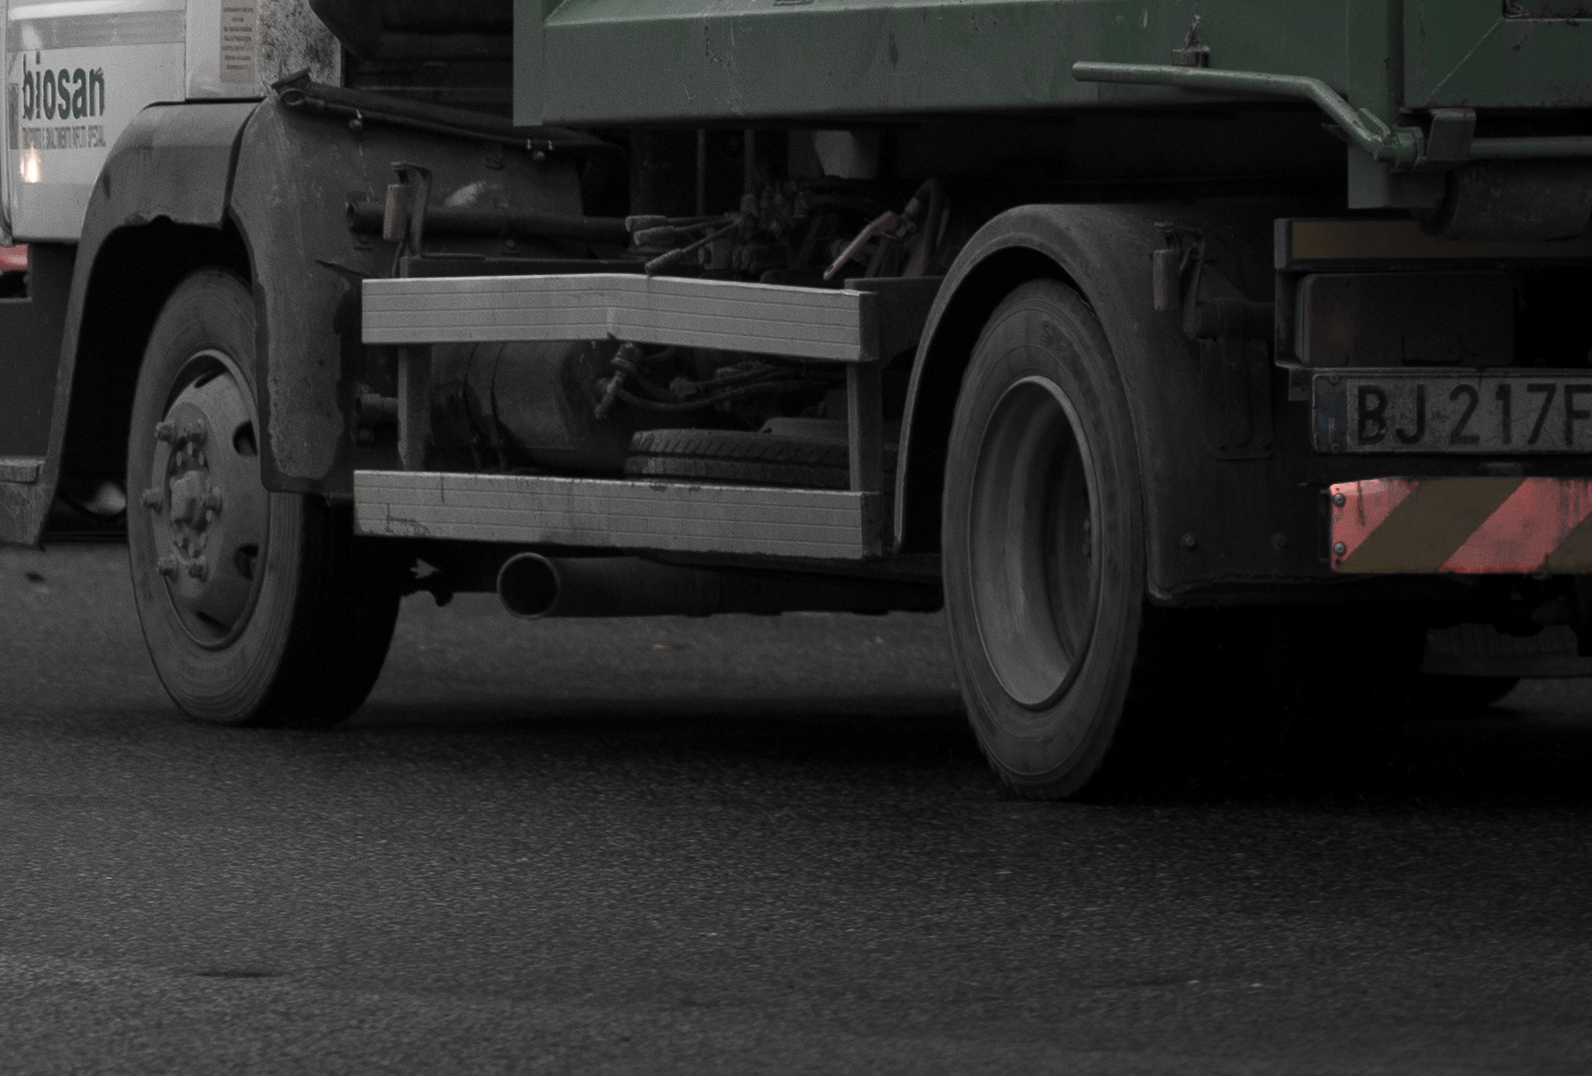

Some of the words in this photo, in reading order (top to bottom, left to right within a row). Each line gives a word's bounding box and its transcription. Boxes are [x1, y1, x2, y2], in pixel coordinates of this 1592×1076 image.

[22, 51, 105, 120] biosan
[1357, 383, 1426, 446] BJ
[1448, 382, 1592, 445] 217F
